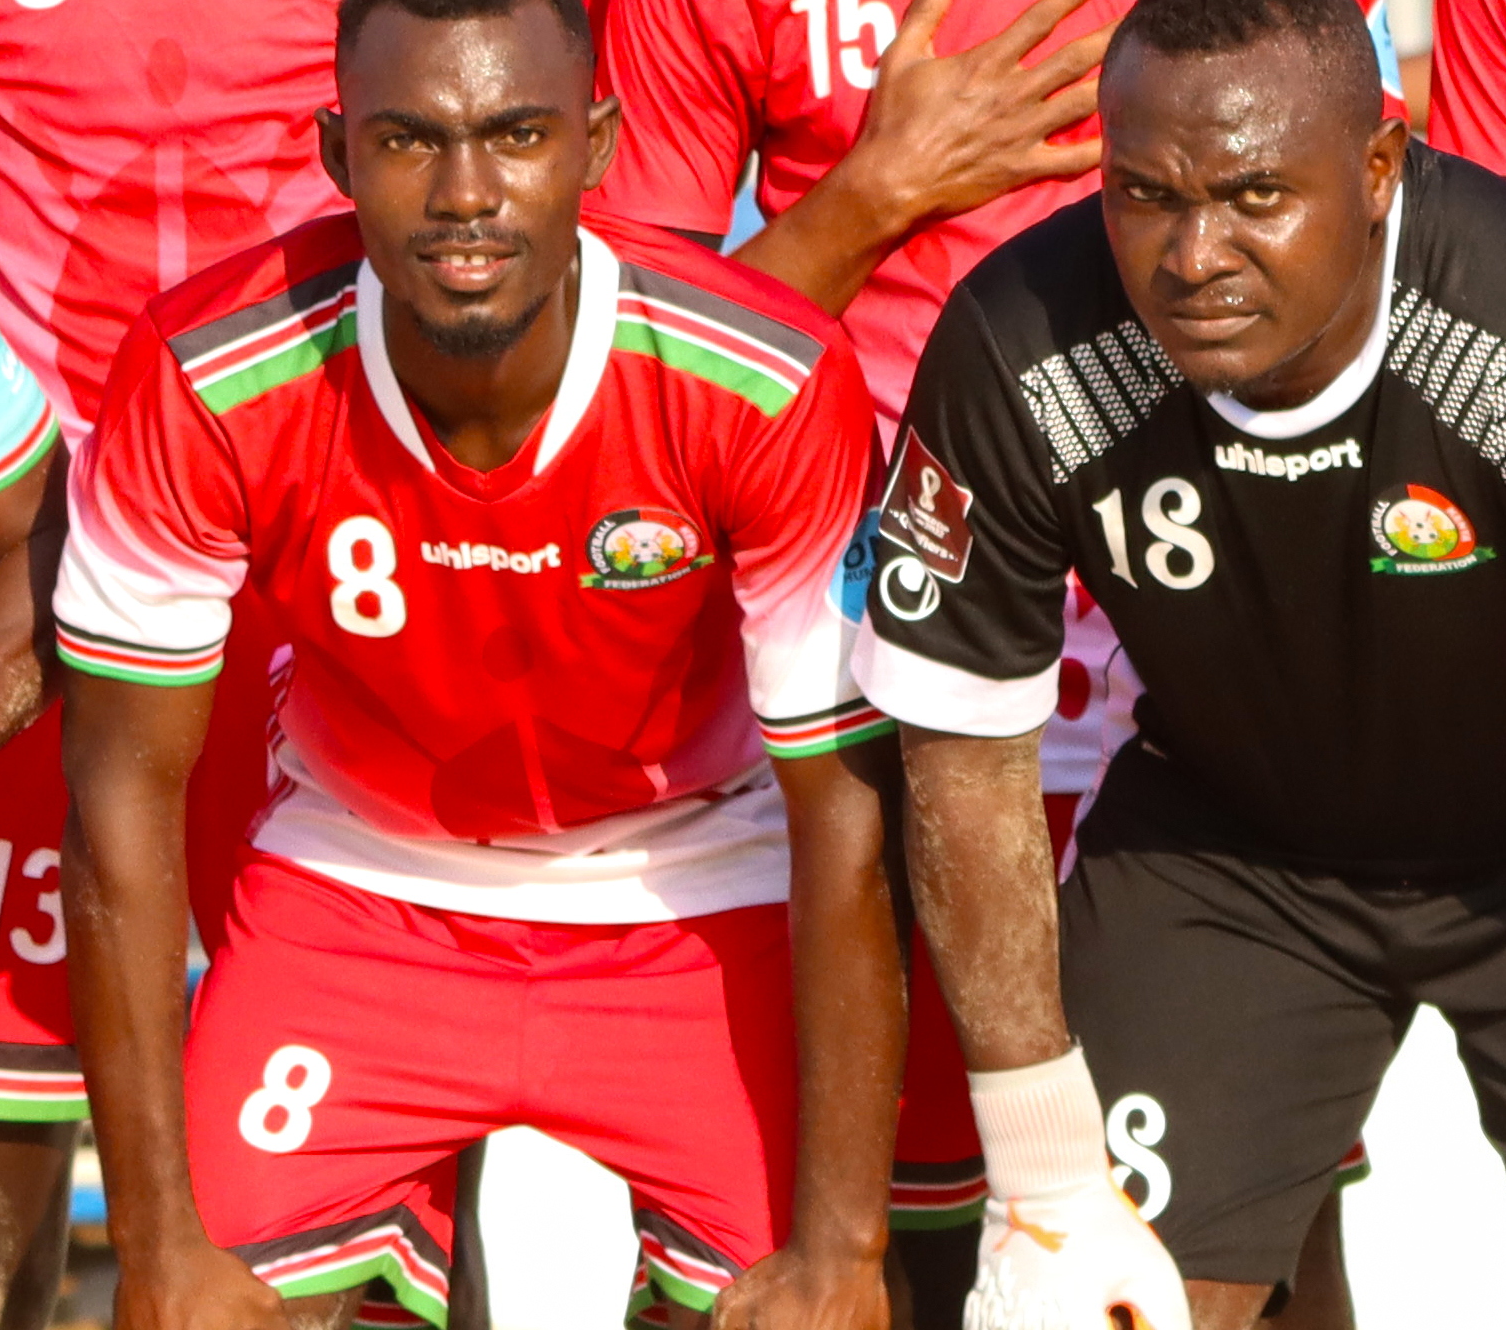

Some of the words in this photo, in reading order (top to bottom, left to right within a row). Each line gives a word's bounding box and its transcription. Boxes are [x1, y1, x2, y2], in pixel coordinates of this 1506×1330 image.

[1215, 438, 1363, 481] uhlsport
[420, 541, 562, 574] uhlsport
[1092, 477, 1215, 590] 18
[1395, 554, 1478, 574] FEDERATION
[327, 515, 407, 639] 8
[604, 566, 692, 590] FEDERATION
[238, 1043, 332, 1154] 8
[1106, 1092, 1173, 1223] 8
